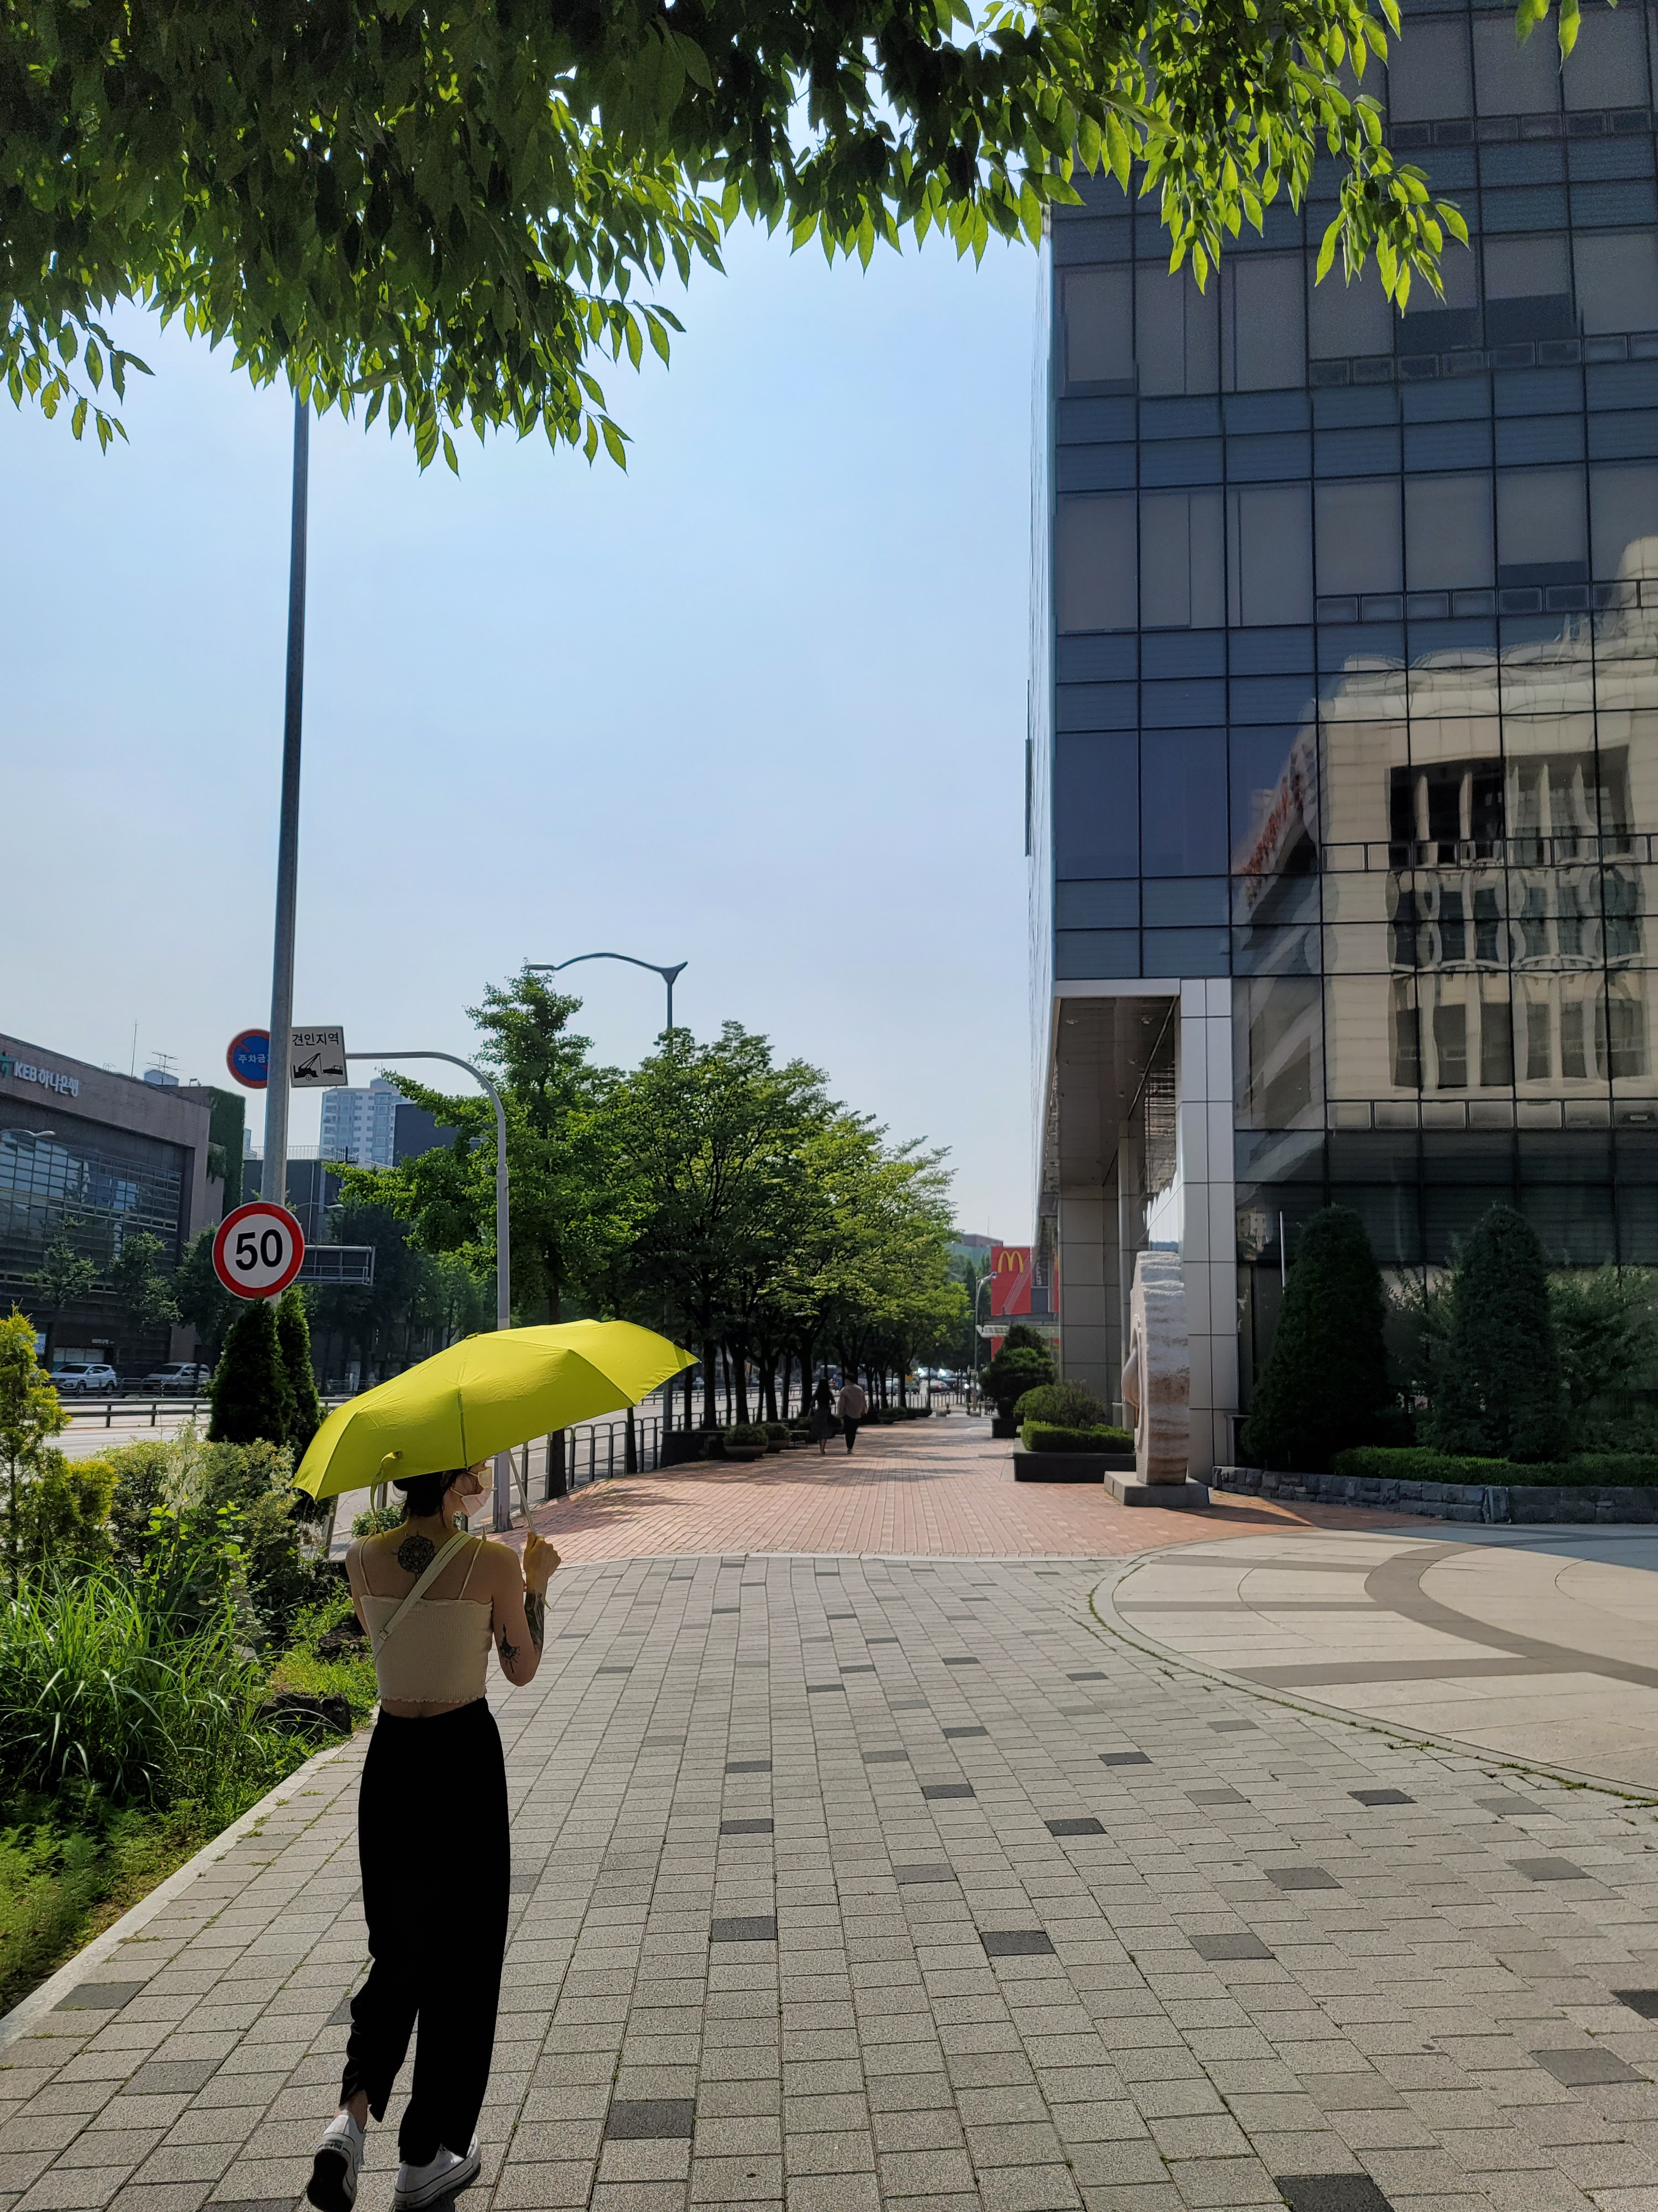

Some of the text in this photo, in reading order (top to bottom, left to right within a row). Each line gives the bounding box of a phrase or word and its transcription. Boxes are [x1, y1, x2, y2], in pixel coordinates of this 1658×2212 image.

[291, 1032, 340, 1046] 견인지역
[238, 1054, 269, 1064] 주차금
[236, 1229, 283, 1271] 50
